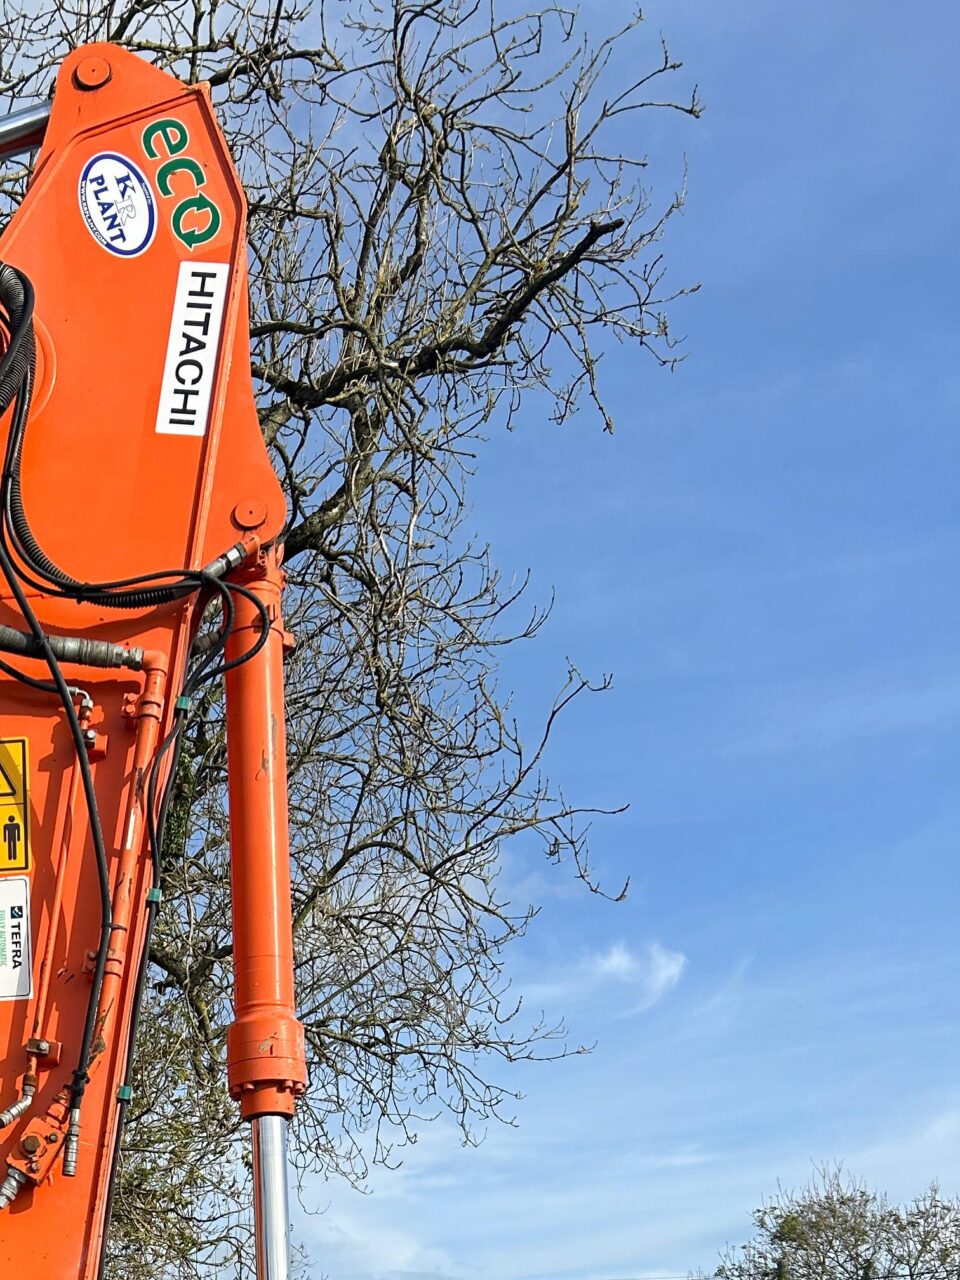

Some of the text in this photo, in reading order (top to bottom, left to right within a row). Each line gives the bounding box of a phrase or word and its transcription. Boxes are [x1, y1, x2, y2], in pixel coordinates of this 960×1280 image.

[89, 174, 126, 243] PLANT
[168, 271, 217, 426] HITACHI
[0, 930, 7, 968] AUTOMATIC
[11, 921, 22, 970] TEFRA
